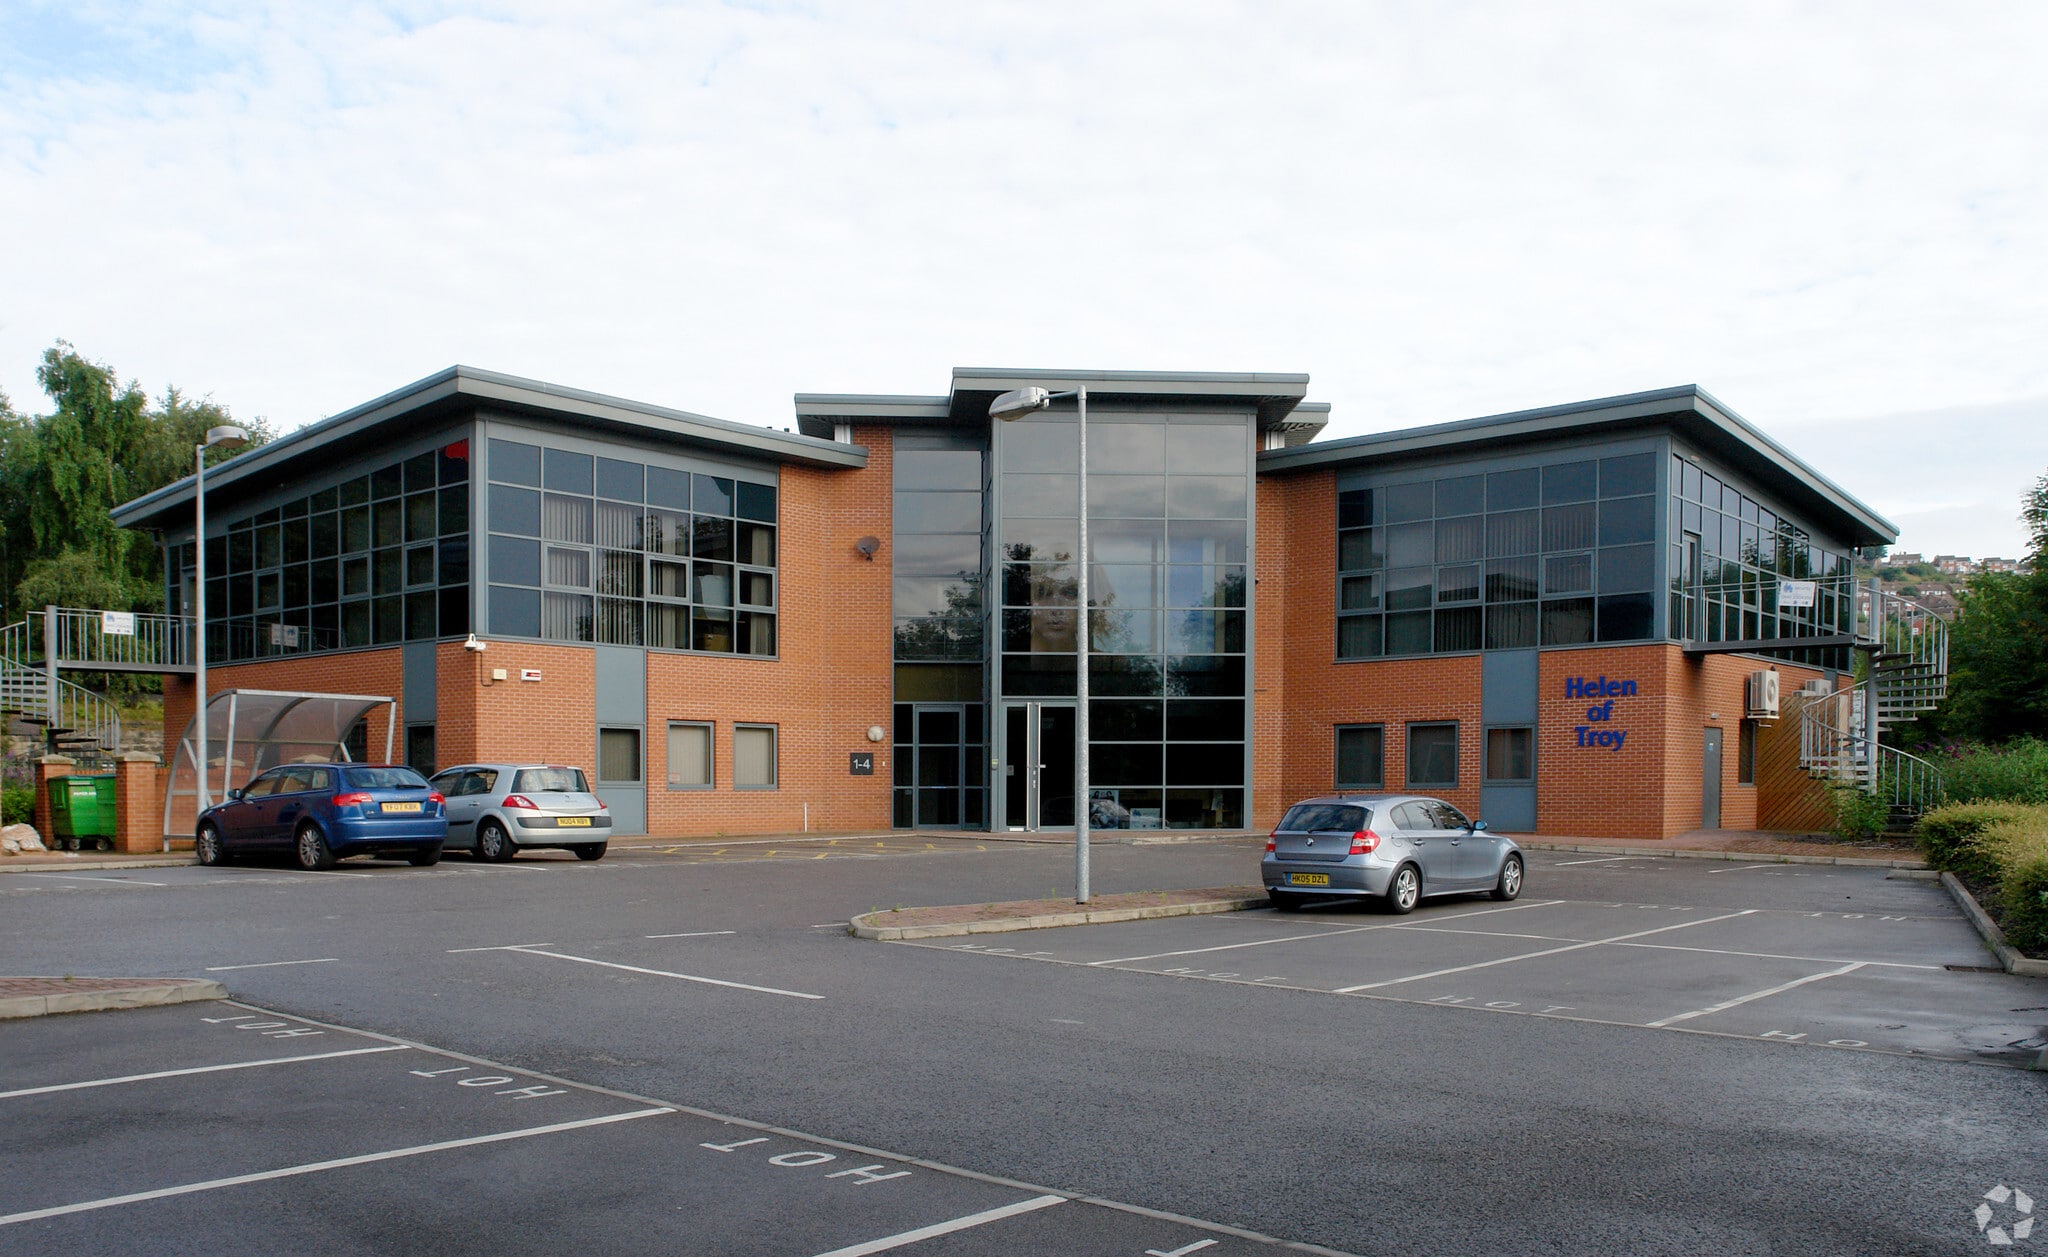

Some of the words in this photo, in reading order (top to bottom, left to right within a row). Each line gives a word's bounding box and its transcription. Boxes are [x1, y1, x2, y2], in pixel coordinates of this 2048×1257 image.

[1566, 676, 1637, 697] Helen
[1587, 700, 1614, 721] of
[1575, 726, 1627, 752] Troy
[853, 759, 871, 769] 1-4
[1292, 875, 1310, 883] HK05
[1312, 876, 1326, 884] DZL
[1431, 995, 1576, 1013] HOT
[201, 1015, 324, 1038] HOT
[409, 1066, 568, 1100] HOT
[700, 1137, 912, 1185] HOT
